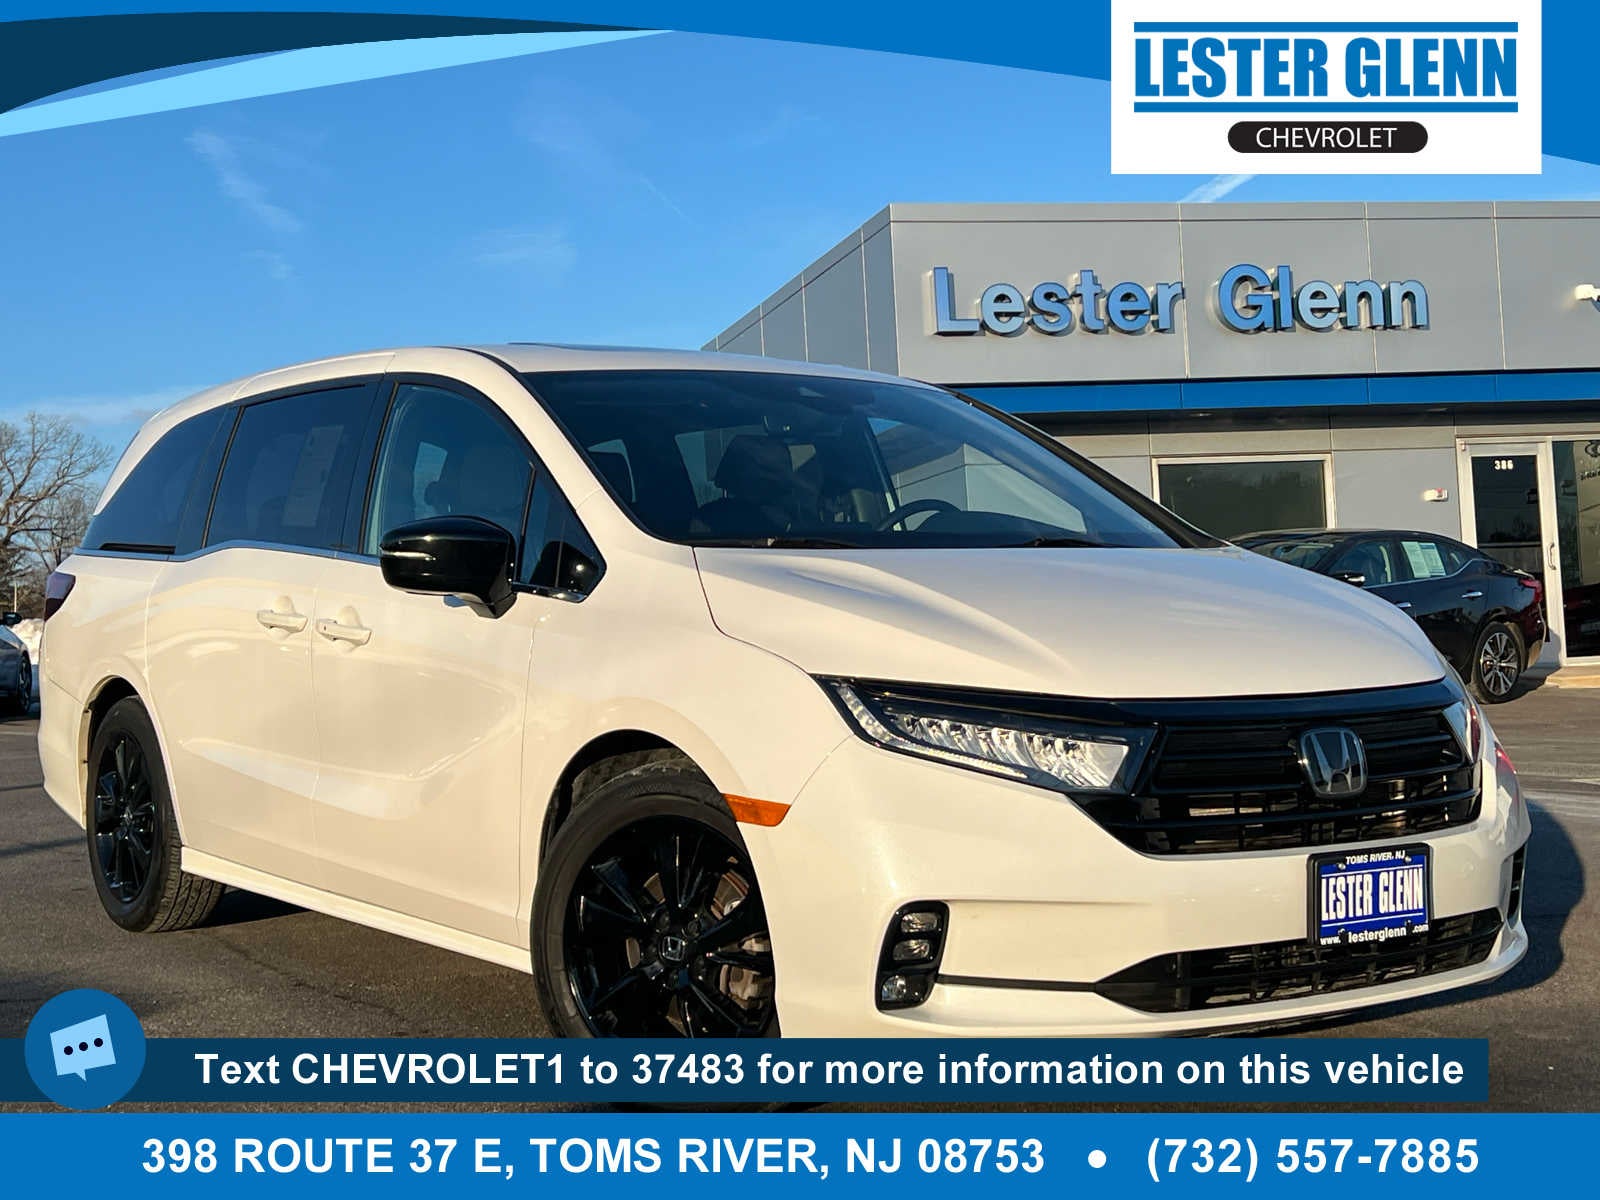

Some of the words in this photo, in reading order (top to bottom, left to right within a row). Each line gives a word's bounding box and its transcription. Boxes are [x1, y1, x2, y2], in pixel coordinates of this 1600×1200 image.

[932, 266, 1185, 335] Lester
[1217, 263, 1429, 332] Glenn
[1345, 854, 1369, 865] TOMS
[1395, 850, 1405, 859] NJ
[1321, 873, 1373, 921] LESTER
[1378, 867, 1424, 914] GLENN
